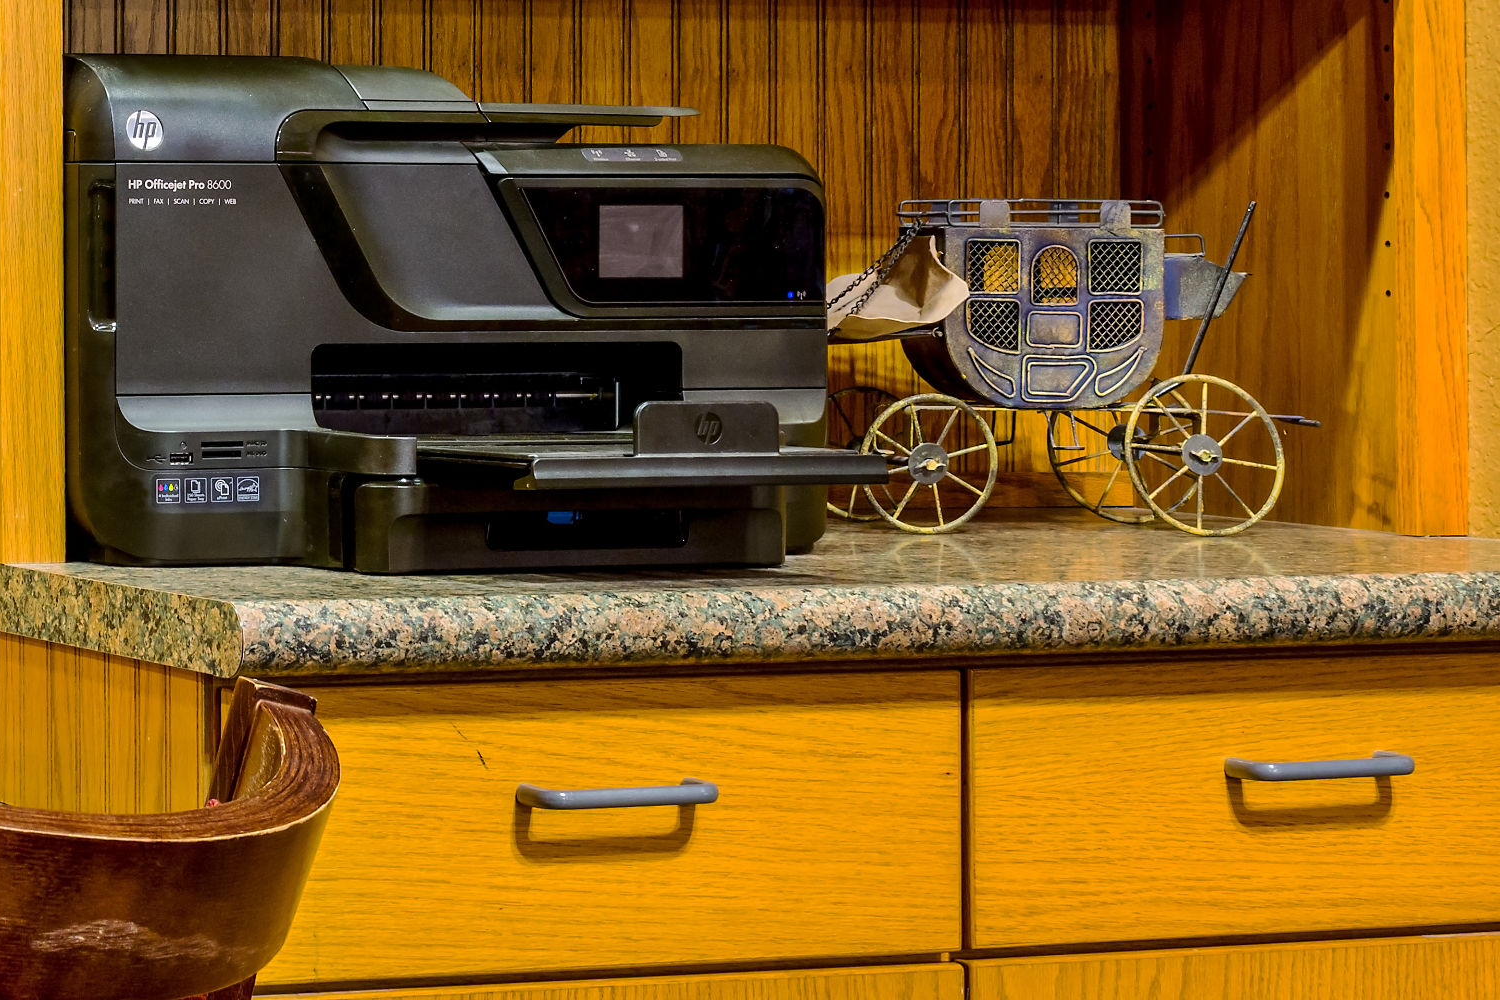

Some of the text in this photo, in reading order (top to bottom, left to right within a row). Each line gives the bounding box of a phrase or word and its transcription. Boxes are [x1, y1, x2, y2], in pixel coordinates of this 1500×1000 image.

[133, 110, 157, 150] hp
[128, 178, 232, 192] HP Officejet Pro 8600
[695, 411, 721, 445] hp
